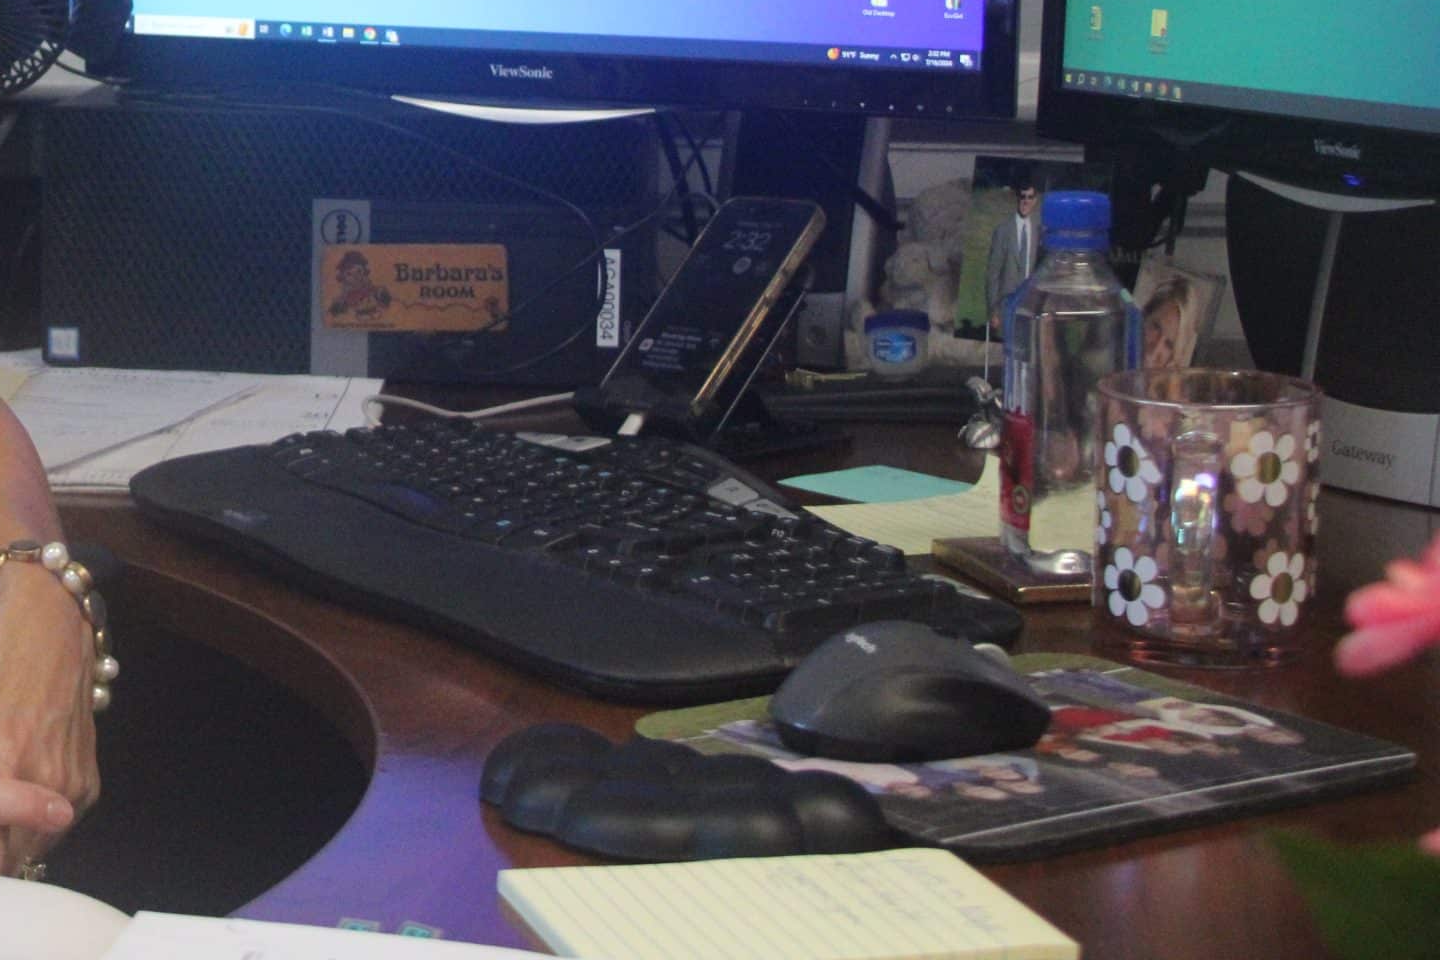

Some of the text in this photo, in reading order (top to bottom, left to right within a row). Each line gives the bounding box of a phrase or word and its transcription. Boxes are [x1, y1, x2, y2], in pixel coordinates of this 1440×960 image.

[489, 64, 553, 79] ViewSonic
[394, 263, 505, 283] Barbara's
[419, 286, 476, 299] ROOM
[1330, 439, 1393, 471] Gateway
